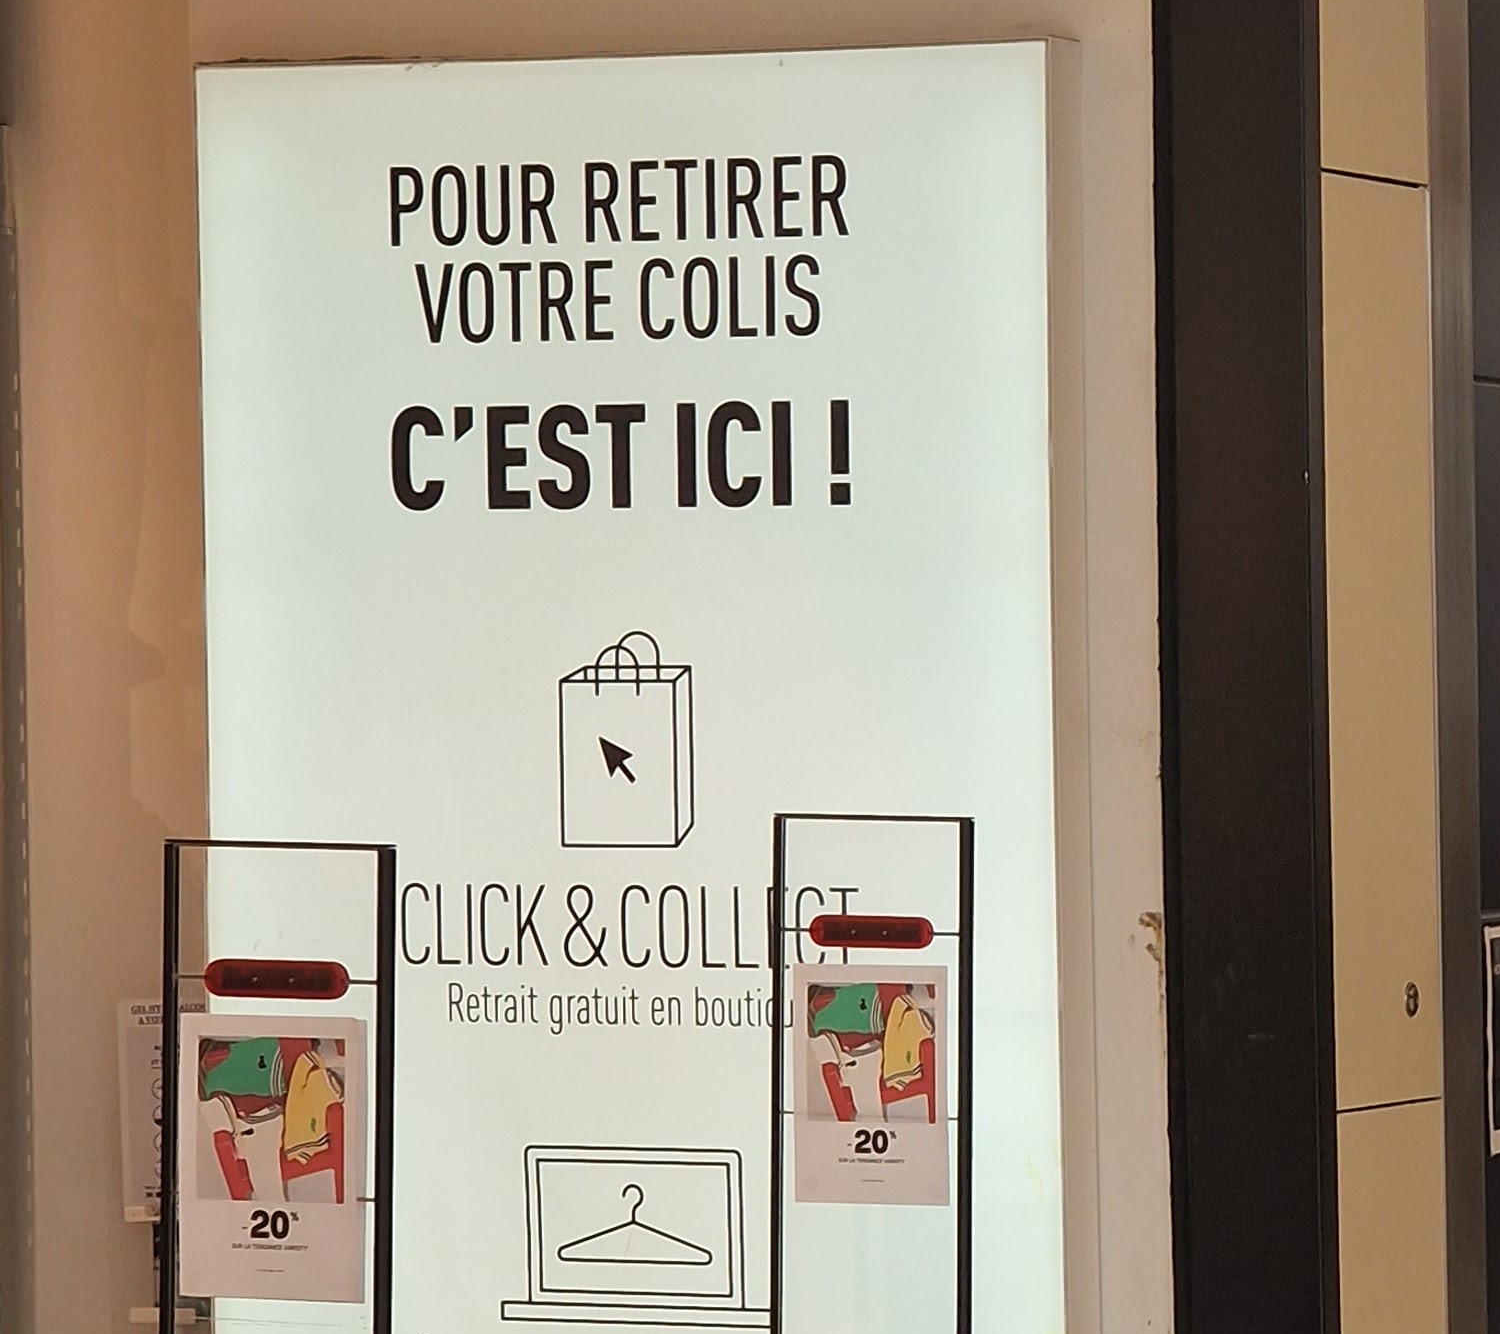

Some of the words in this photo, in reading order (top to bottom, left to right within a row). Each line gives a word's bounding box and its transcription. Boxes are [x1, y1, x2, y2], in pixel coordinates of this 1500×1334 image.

[389, 165, 557, 247] POUR
[584, 154, 849, 243] RETIRER
[415, 260, 614, 343] VOTRE
[639, 255, 821, 339] COLIS
[676, 400, 793, 508] ICI
[400, 882, 549, 967] CLICK
[563, 882, 609, 969] &
[448, 983, 538, 1026] Retrait
[550, 987, 641, 1036] gratuit
[651, 998, 683, 1027] en
